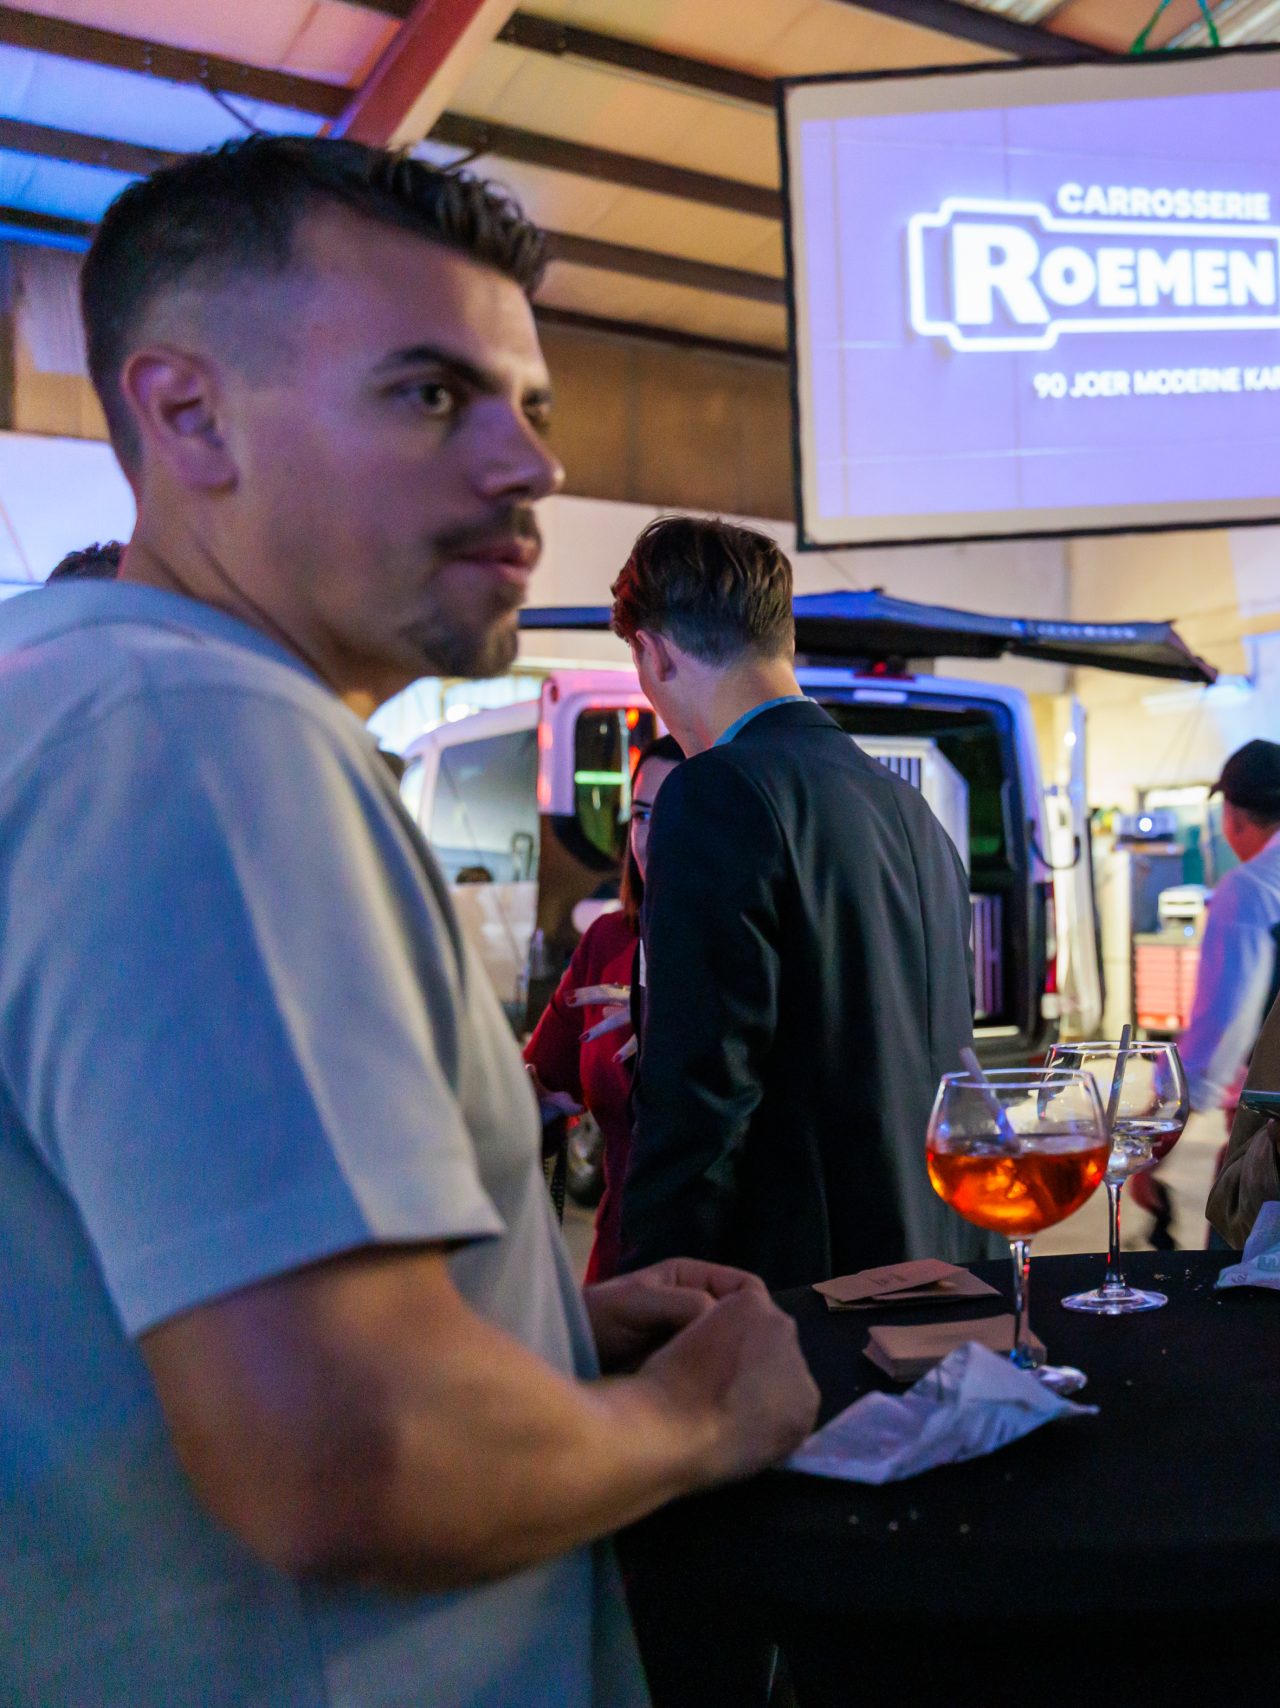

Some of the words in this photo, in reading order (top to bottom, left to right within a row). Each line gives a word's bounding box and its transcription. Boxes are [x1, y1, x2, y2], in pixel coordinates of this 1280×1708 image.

[1057, 183, 1269, 221] CARROSSERIE
[949, 222, 1275, 326] ROEMEN
[1033, 372, 1067, 398] 90
[1070, 371, 1130, 396] JOER
[1134, 367, 1241, 394] MODERNE
